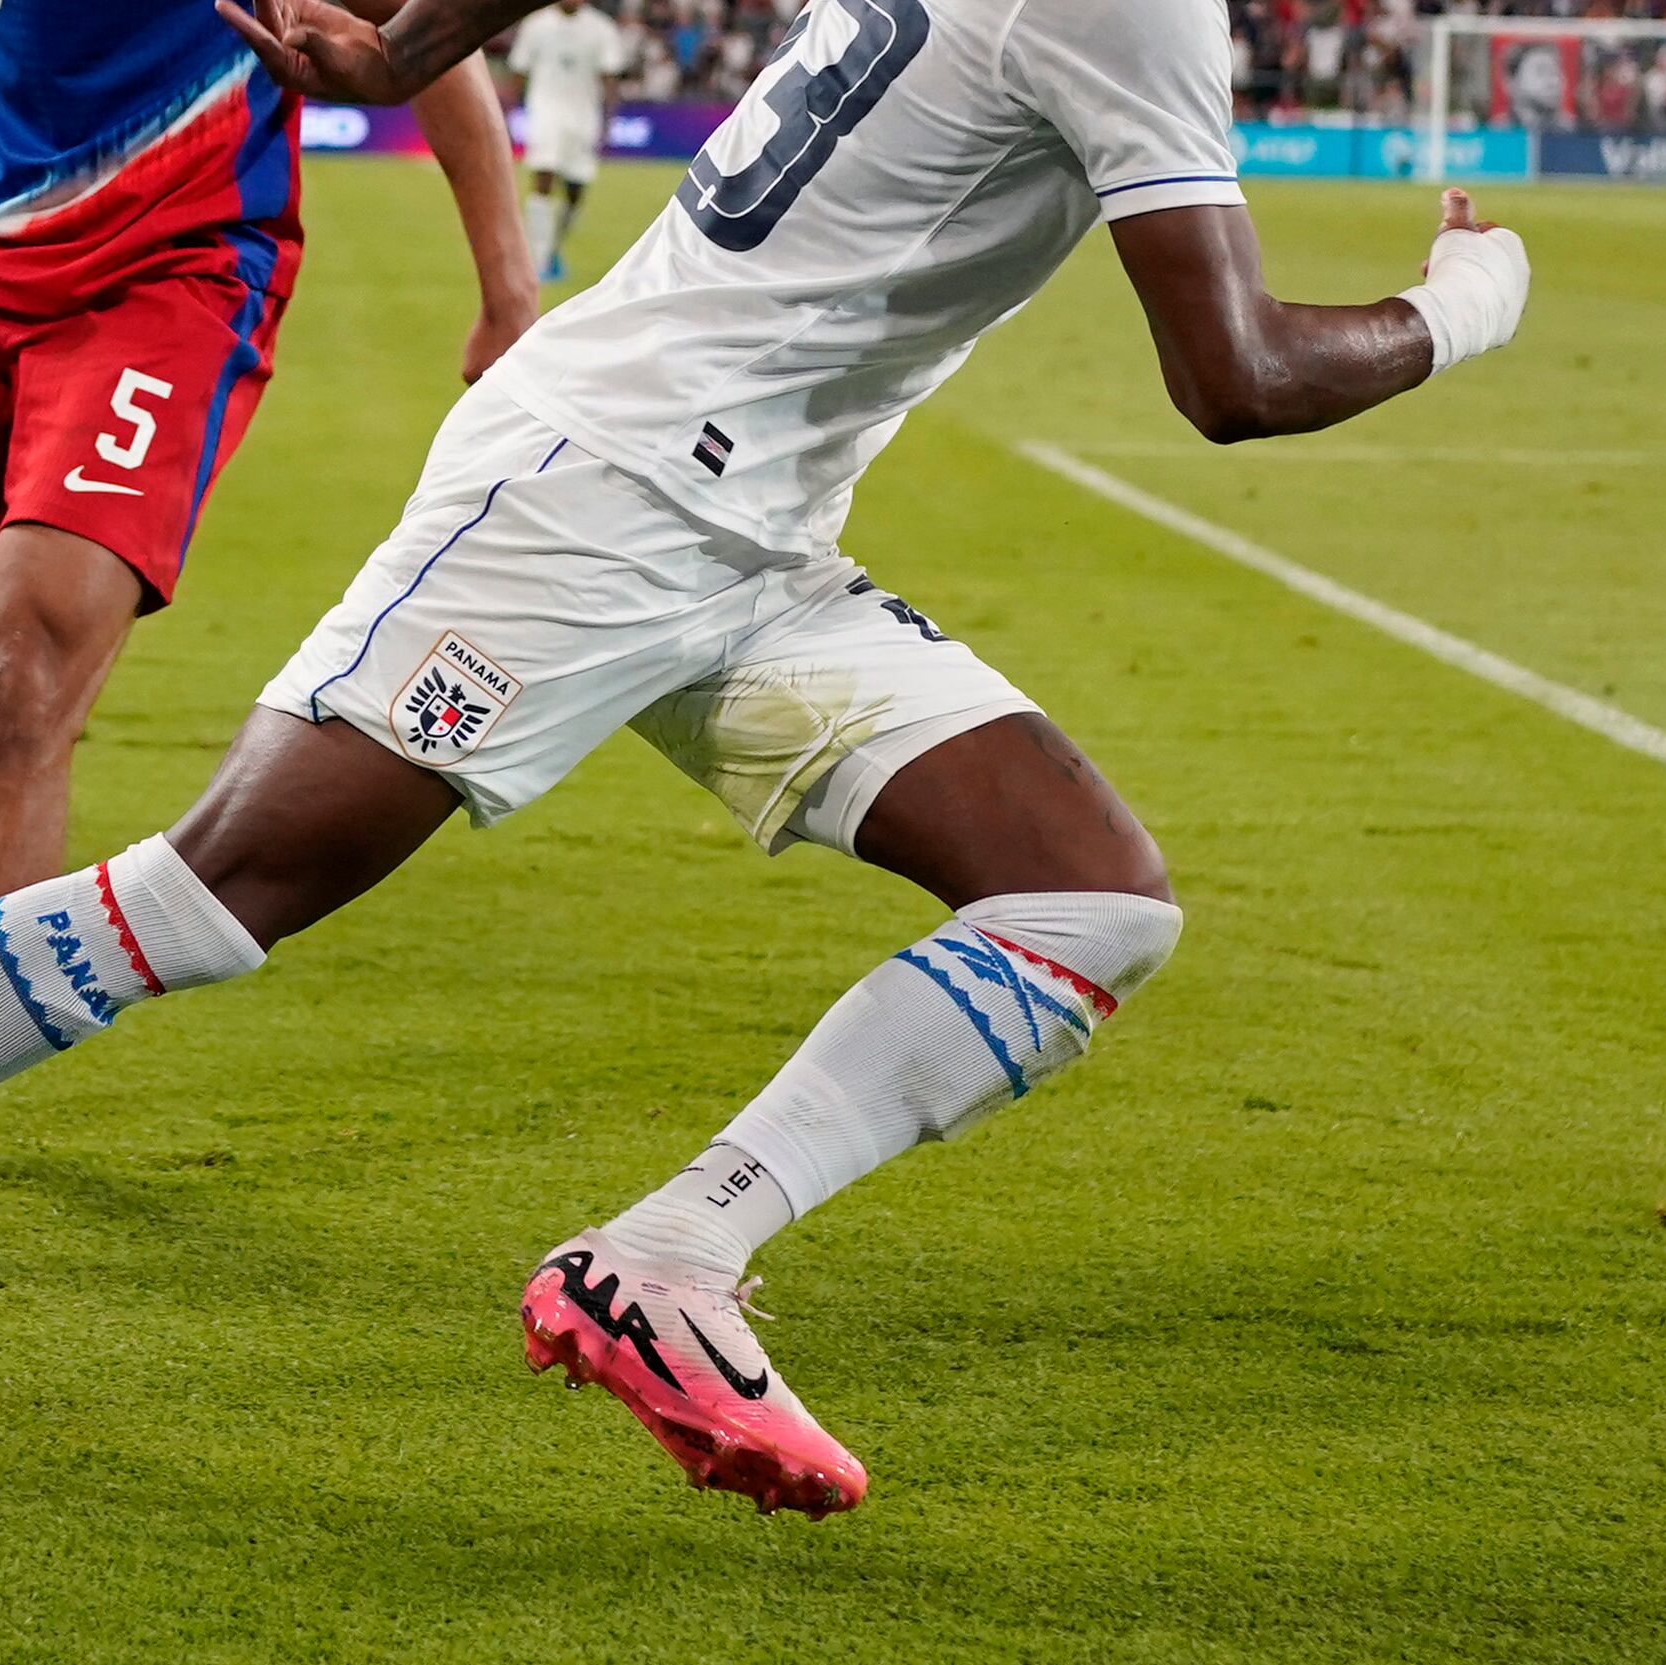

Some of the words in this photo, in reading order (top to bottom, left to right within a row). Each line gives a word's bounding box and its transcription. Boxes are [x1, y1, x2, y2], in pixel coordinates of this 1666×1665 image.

[95, 367, 173, 470] 5
[445, 641, 511, 696] PANAMÁ
[37, 910, 121, 1025] PANA
